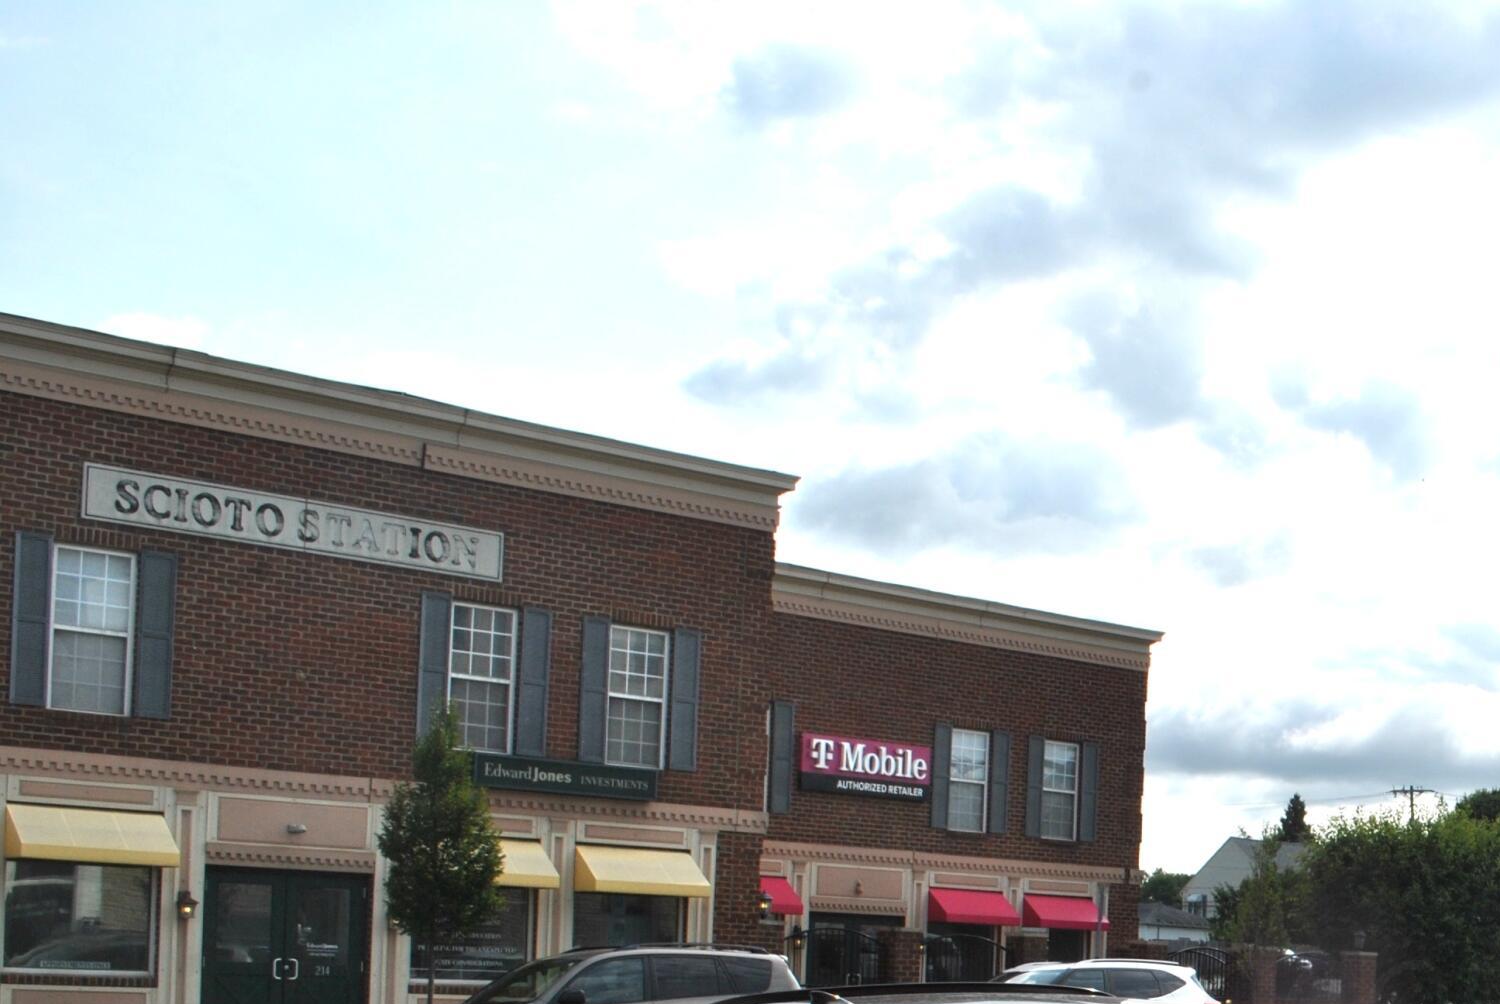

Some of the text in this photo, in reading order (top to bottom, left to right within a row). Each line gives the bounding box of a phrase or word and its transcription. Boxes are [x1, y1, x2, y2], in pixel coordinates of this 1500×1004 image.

[114, 478, 481, 570] SCIOTO STATION
[811, 738, 928, 780] T Mobile
[580, 775, 649, 791] INVESTMENTS
[837, 779, 923, 797] AUTHORIZED RETAILER
